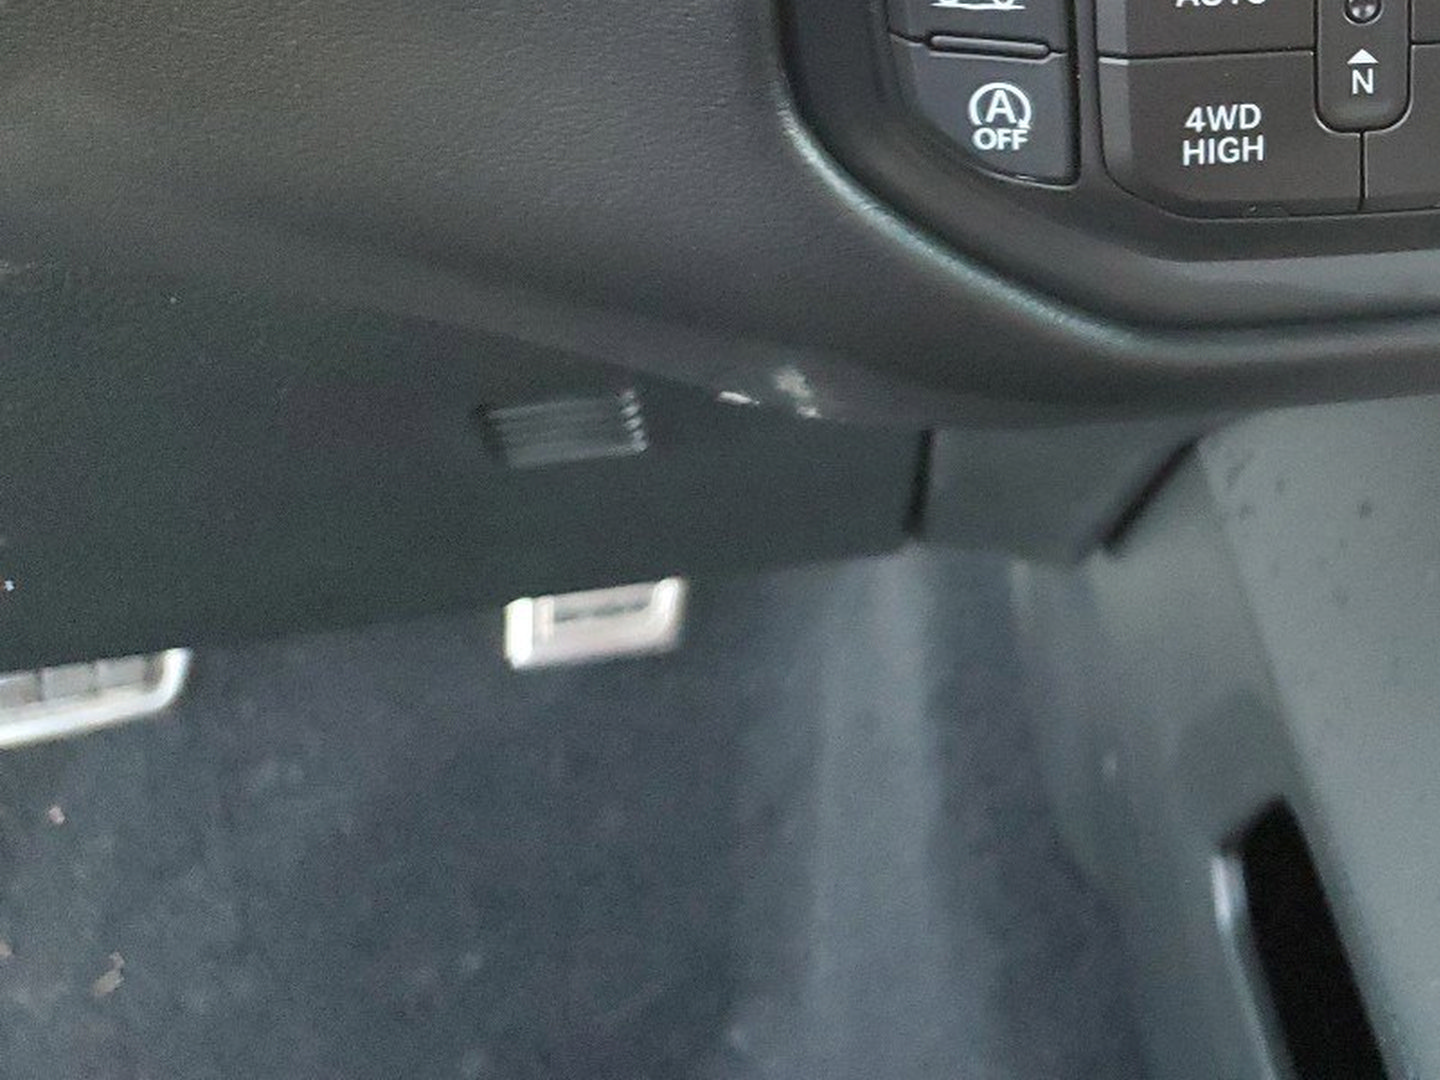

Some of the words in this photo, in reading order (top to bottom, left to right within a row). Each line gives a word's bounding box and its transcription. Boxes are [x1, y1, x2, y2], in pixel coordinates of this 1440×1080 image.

[1351, 68, 1374, 95] N
[1184, 103, 1262, 132] 4WD
[972, 127, 1028, 151] OFF
[1182, 134, 1264, 166] HIGH
